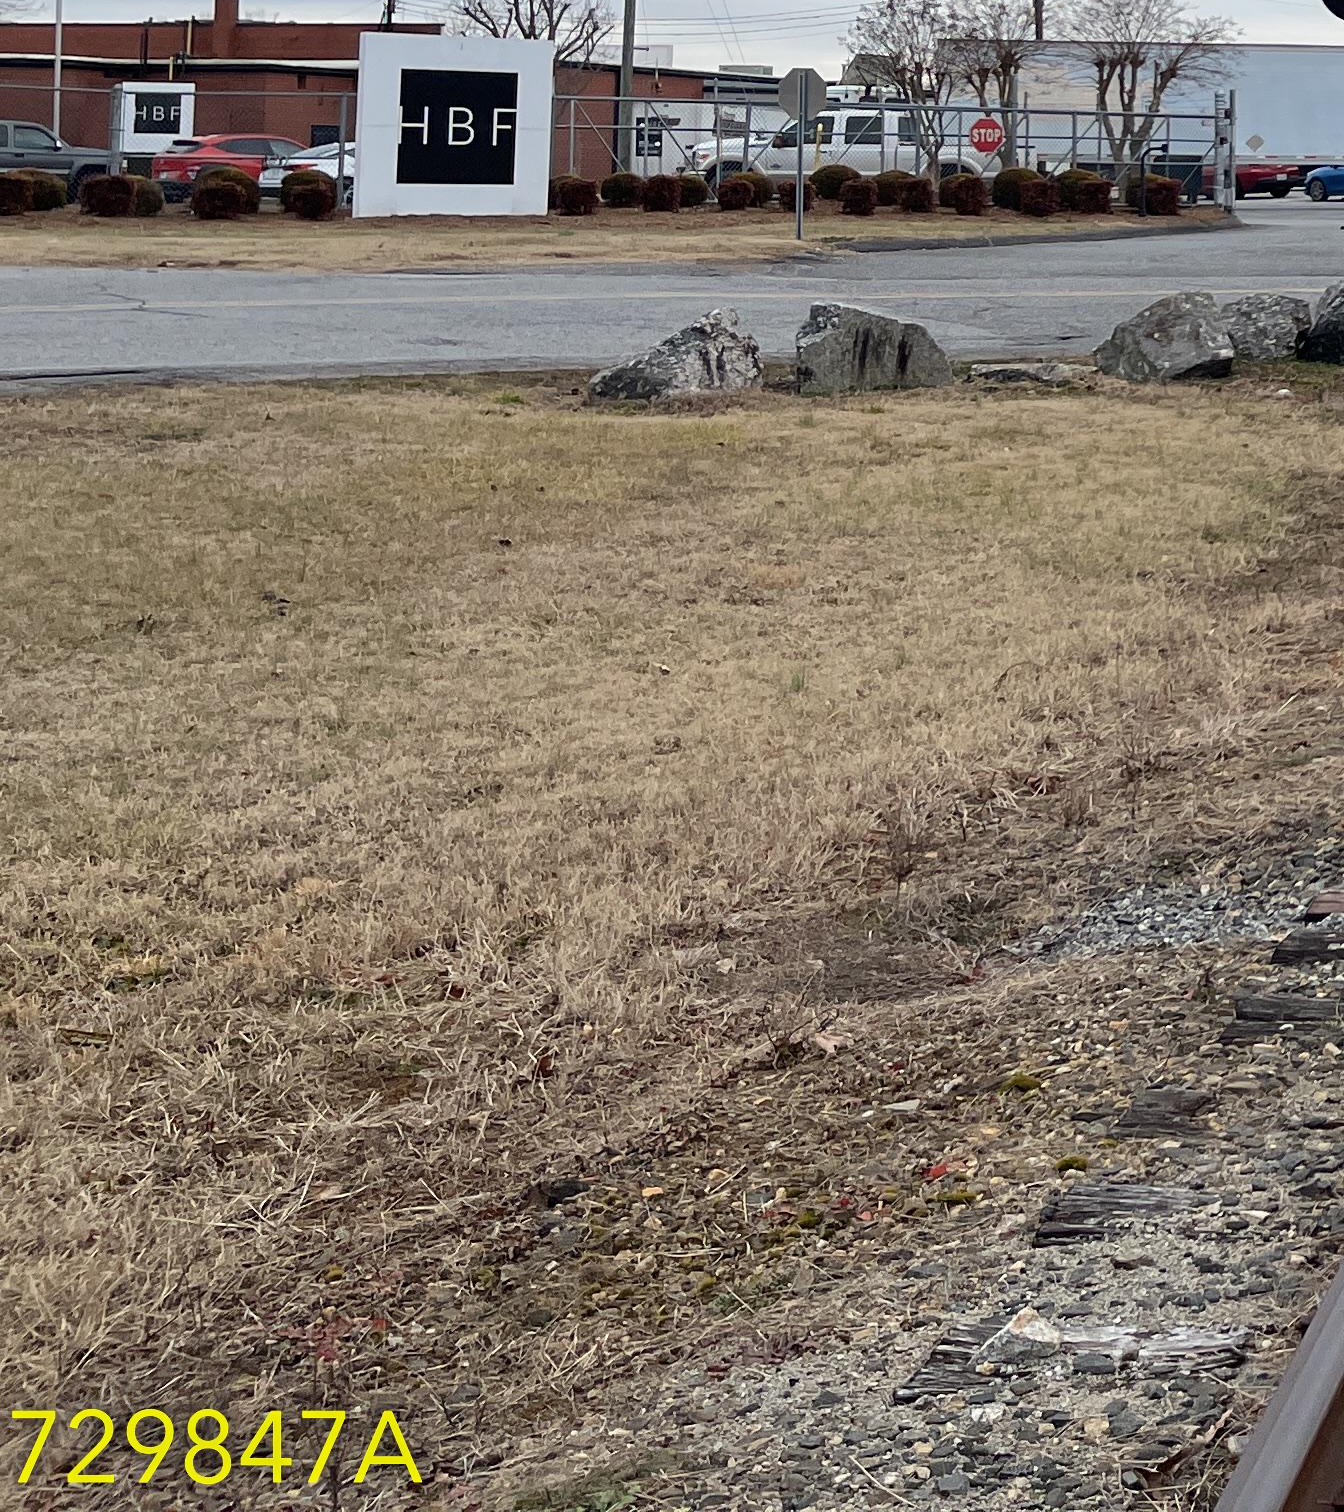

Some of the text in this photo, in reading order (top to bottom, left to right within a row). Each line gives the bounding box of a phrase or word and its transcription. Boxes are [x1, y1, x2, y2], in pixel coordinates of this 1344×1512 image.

[135, 105, 181, 121] HBF
[398, 105, 518, 146] HBF
[972, 128, 1001, 143] STOP
